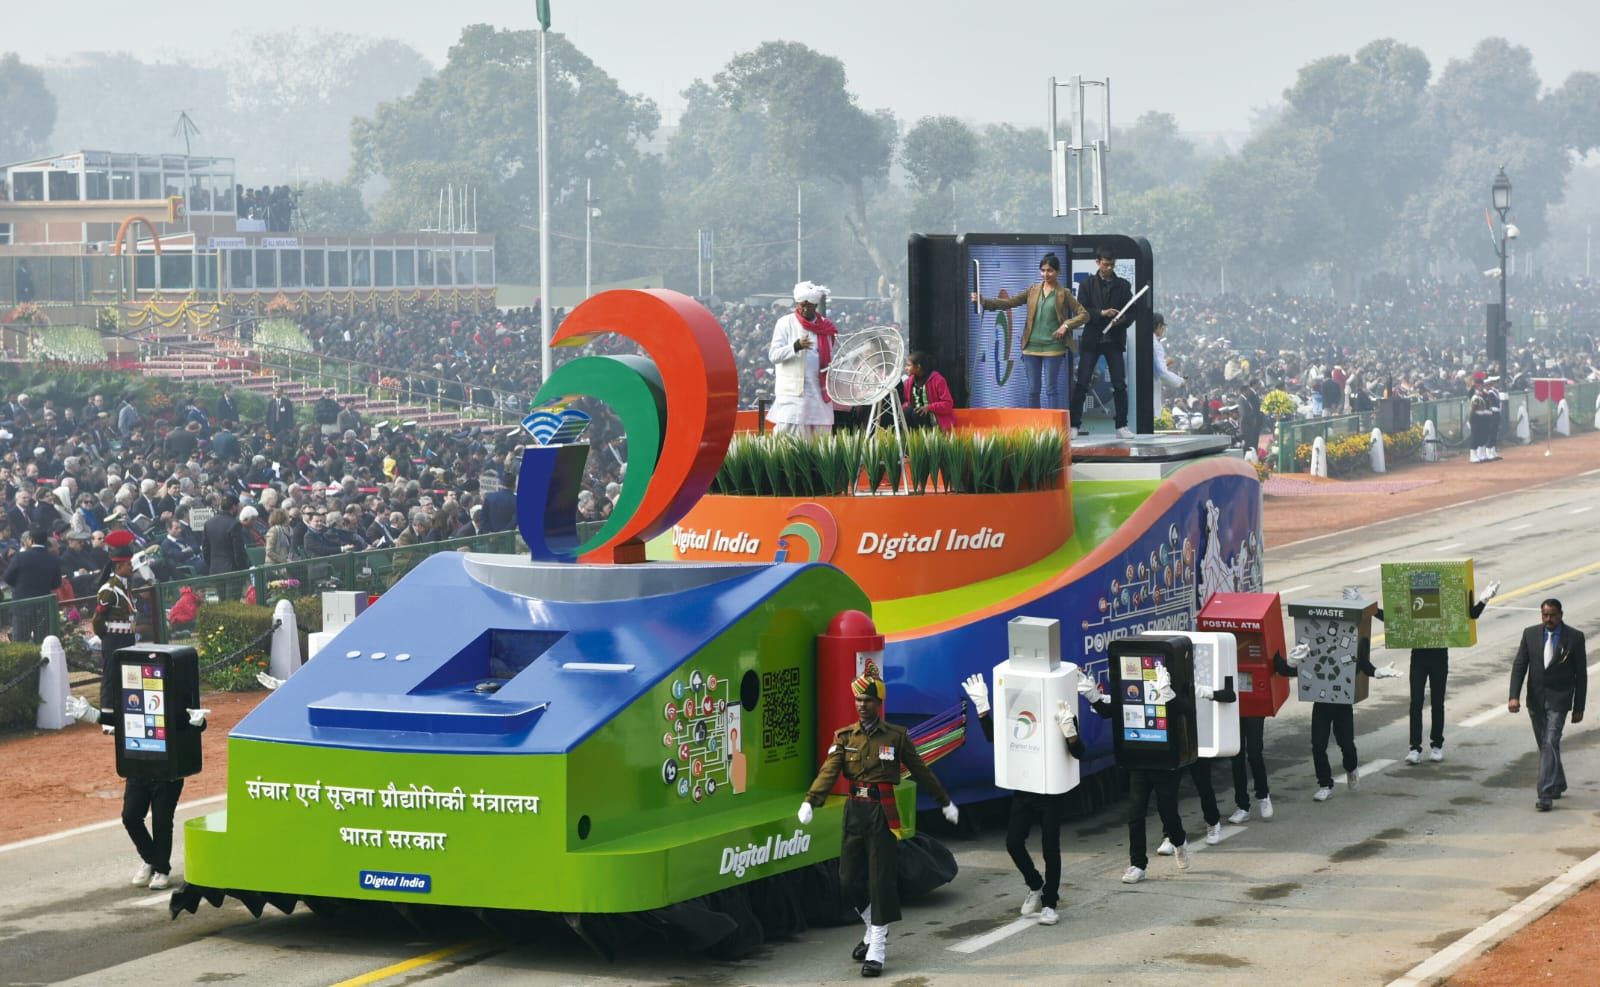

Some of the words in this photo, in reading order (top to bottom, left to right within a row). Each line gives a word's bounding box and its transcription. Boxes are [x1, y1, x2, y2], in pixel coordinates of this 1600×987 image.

[672, 524, 711, 553] Digital
[712, 529, 760, 554] India
[857, 528, 940, 559] Digital
[946, 526, 1005, 551] India
[1202, 620, 1238, 629] POSTAL
[1240, 622, 1260, 630] ATM
[1308, 608, 1344, 618] e-WASTE
[246, 775, 290, 801] संचार
[294, 779, 321, 808] एवं
[326, 785, 374, 811] सूचना
[379, 782, 466, 812] प्रौद्योगिकी
[471, 788, 540, 815] मंत्रालय
[339, 826, 382, 848] भारत
[386, 829, 448, 852] सरकार
[720, 835, 772, 878] Digital
[773, 829, 811, 860] India
[364, 873, 397, 889] Digital
[399, 875, 425, 889] India
